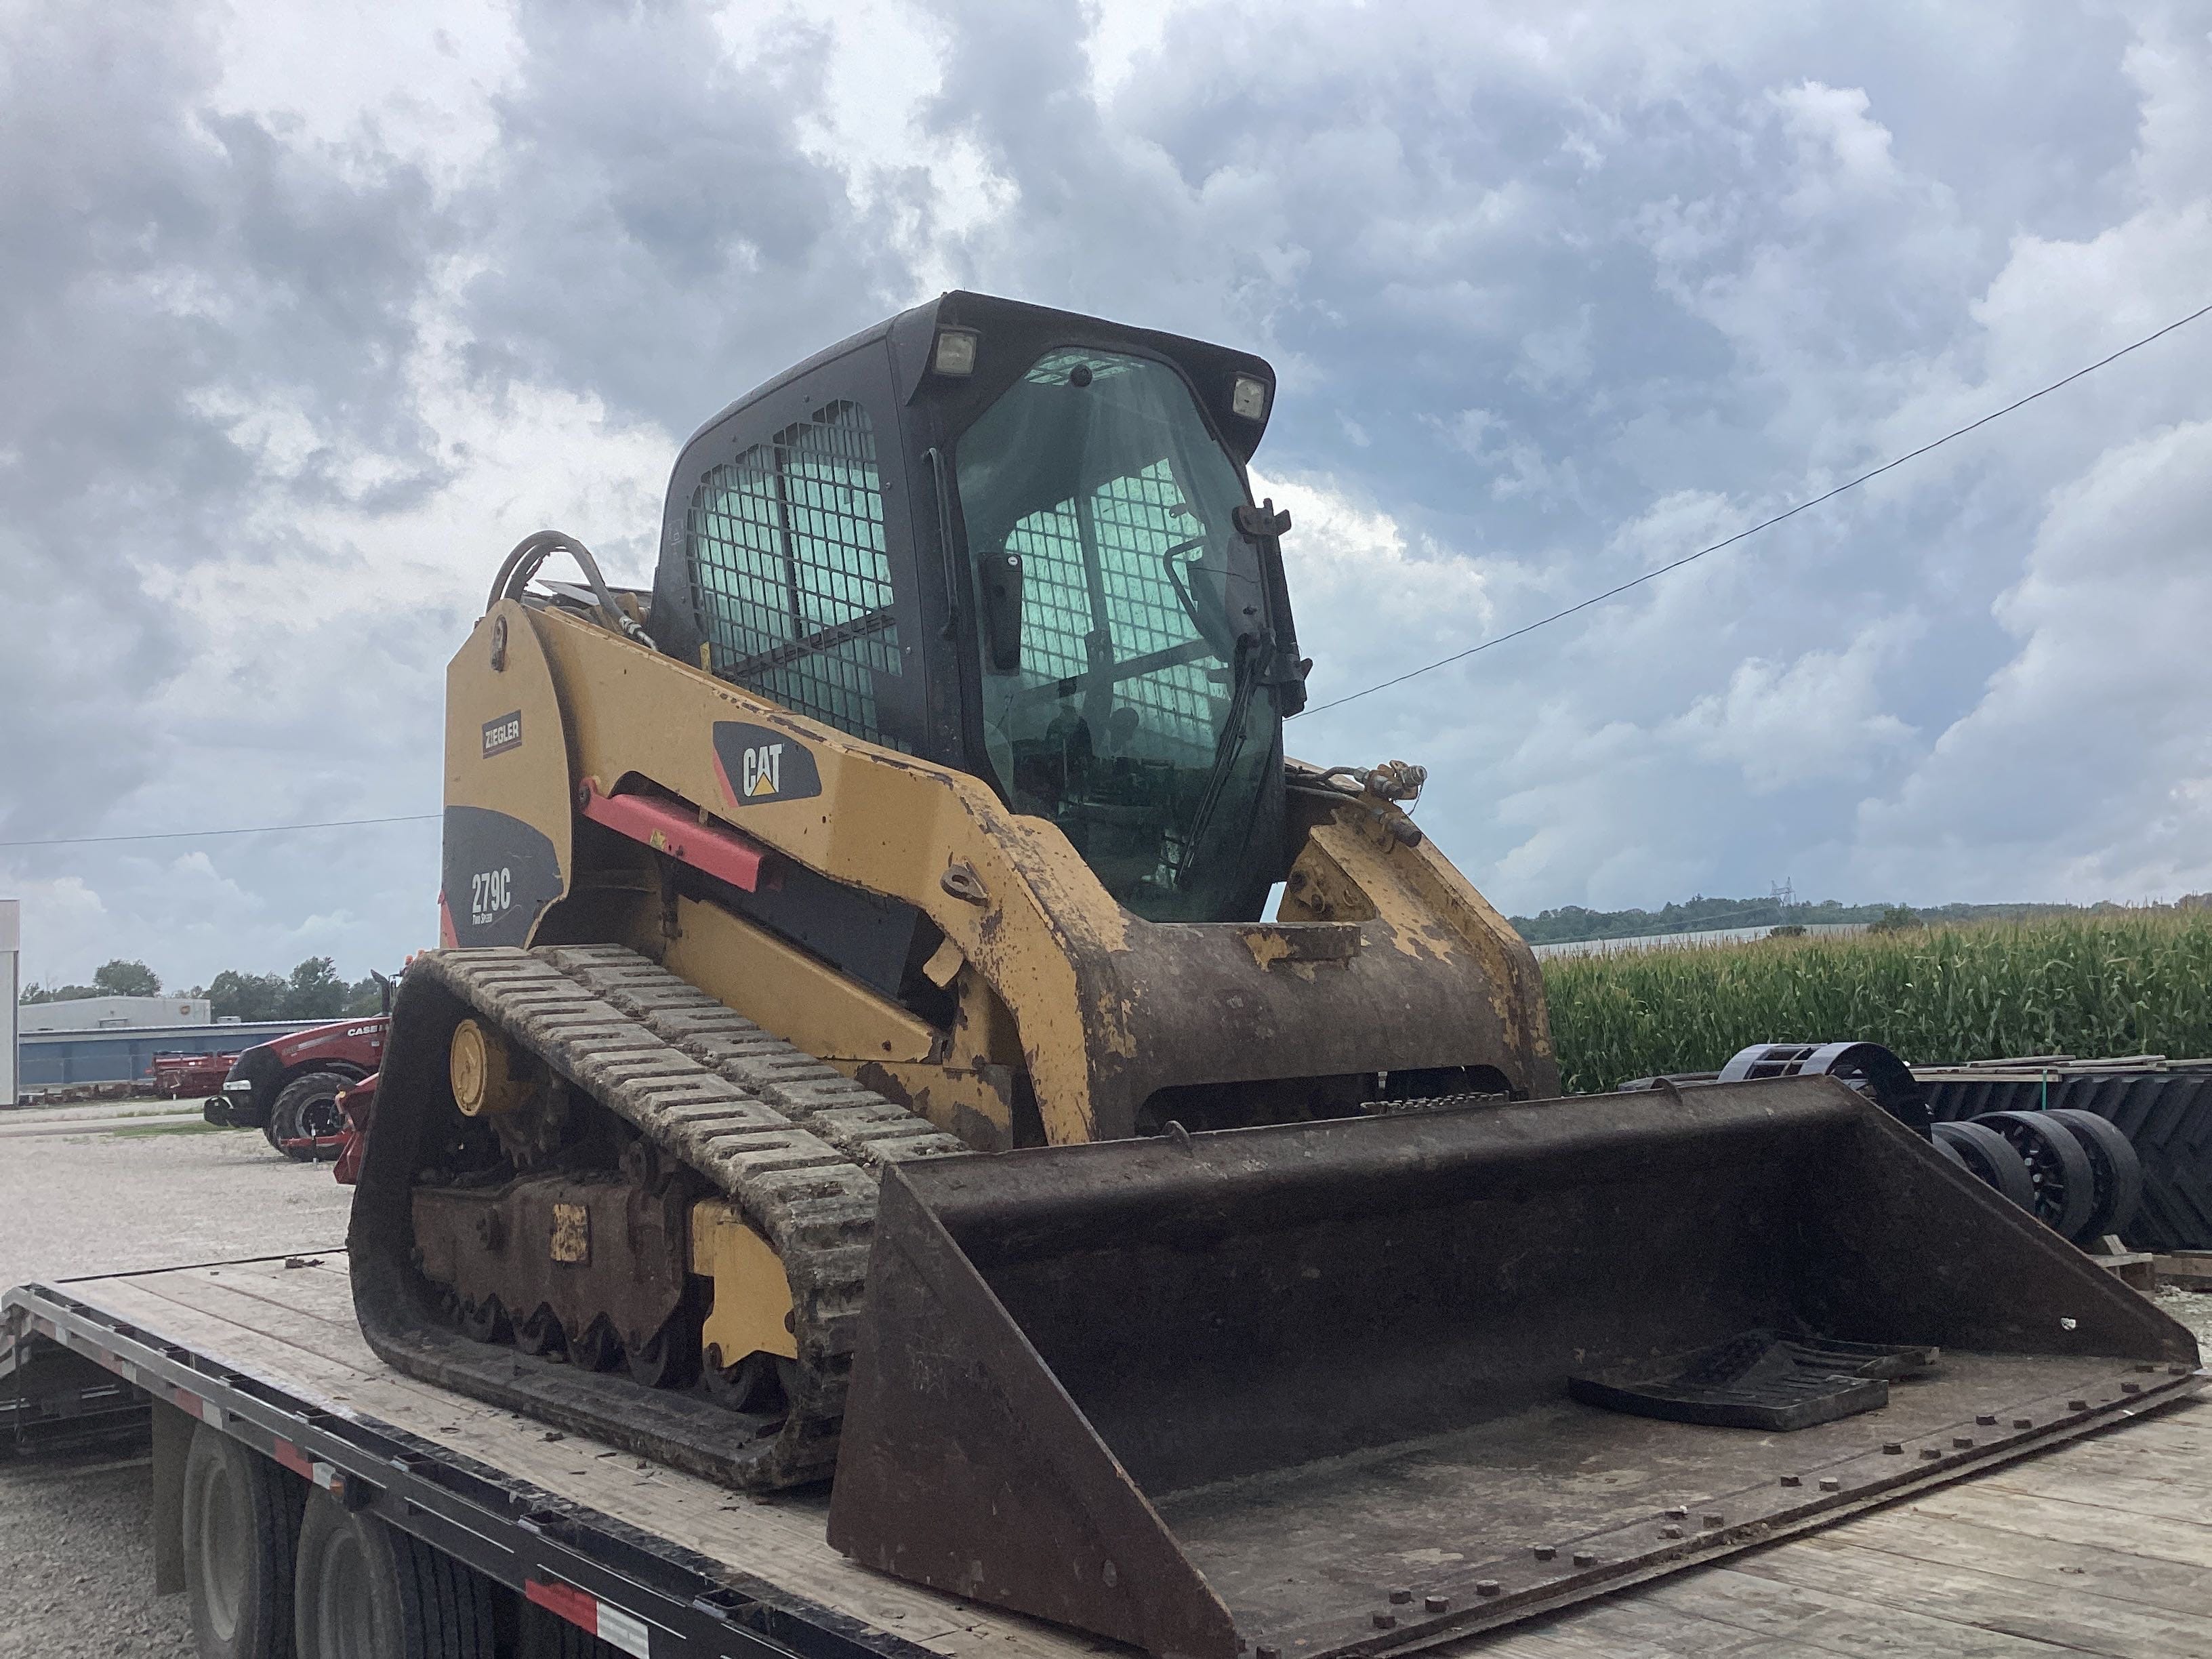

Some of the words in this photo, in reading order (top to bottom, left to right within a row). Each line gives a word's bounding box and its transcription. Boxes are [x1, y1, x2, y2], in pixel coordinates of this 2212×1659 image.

[485, 720, 519, 749] ZIEGLER
[743, 743, 783, 797] CAT
[472, 867, 510, 913] 279C
[347, 1025, 378, 1037] CASE
